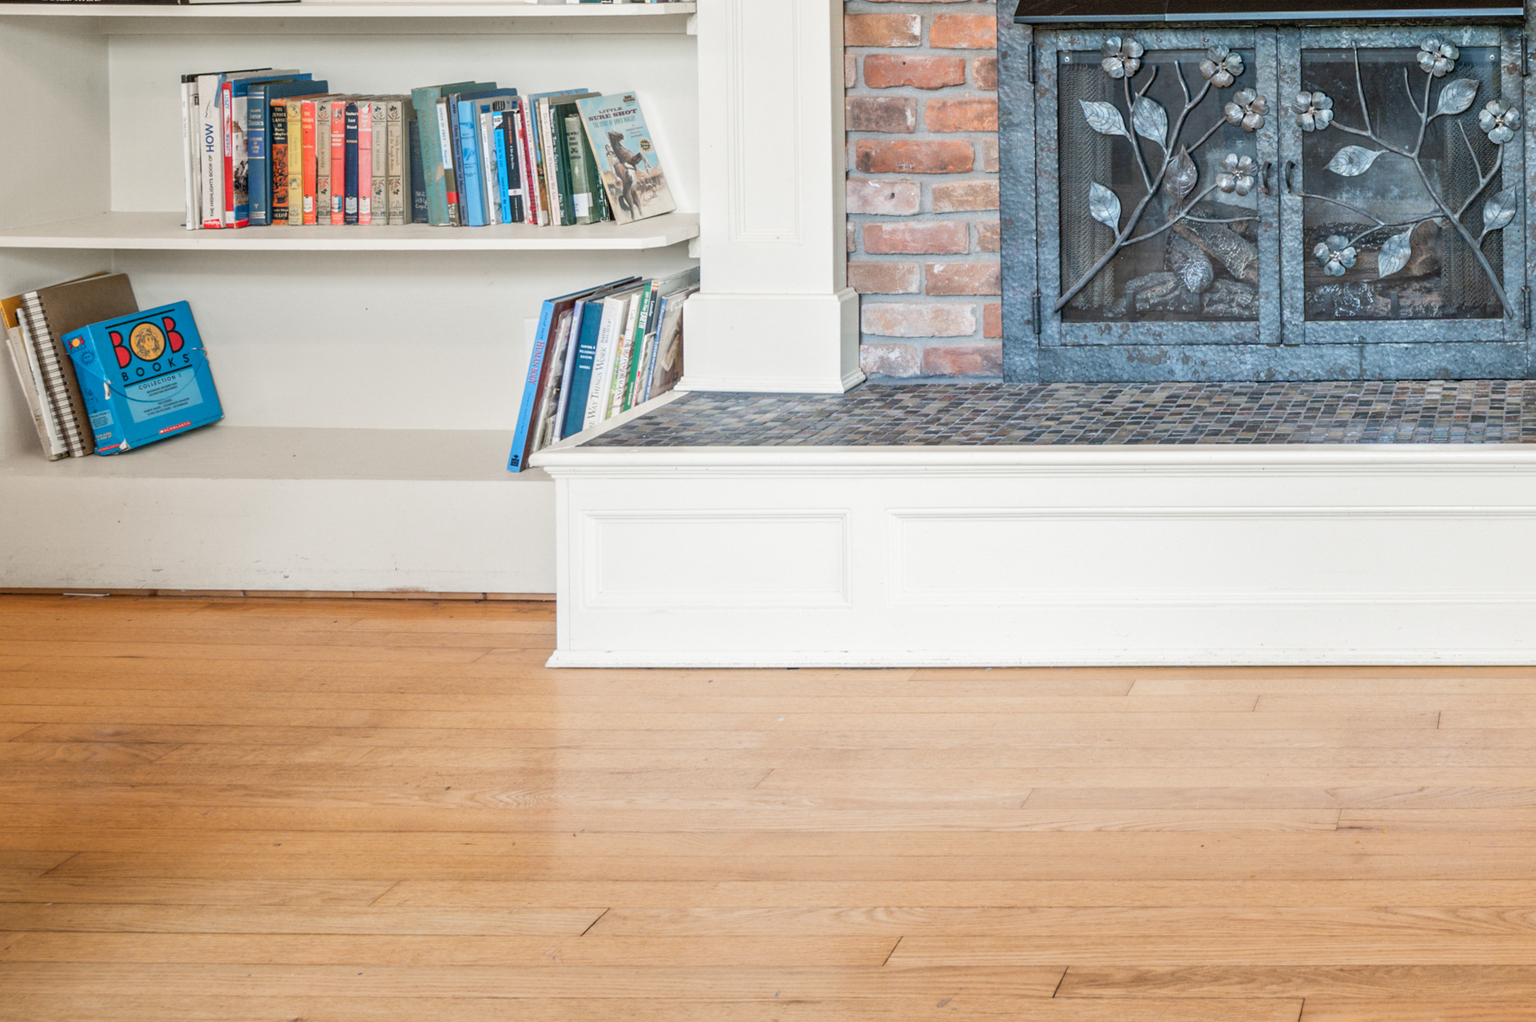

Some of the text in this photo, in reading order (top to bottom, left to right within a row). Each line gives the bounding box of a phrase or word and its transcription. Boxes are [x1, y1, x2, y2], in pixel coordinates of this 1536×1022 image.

[588, 108, 637, 121] SURE SHOT
[205, 123, 214, 153] HOW
[109, 316, 185, 369] BOB
[121, 354, 190, 381] BOOKS
[528, 340, 545, 385] HUMAN BODY
[138, 374, 176, 390] COLLECTION
[587, 347, 607, 419] WAY THINGS WORK
[163, 421, 191, 433] SCHOLASTIC
